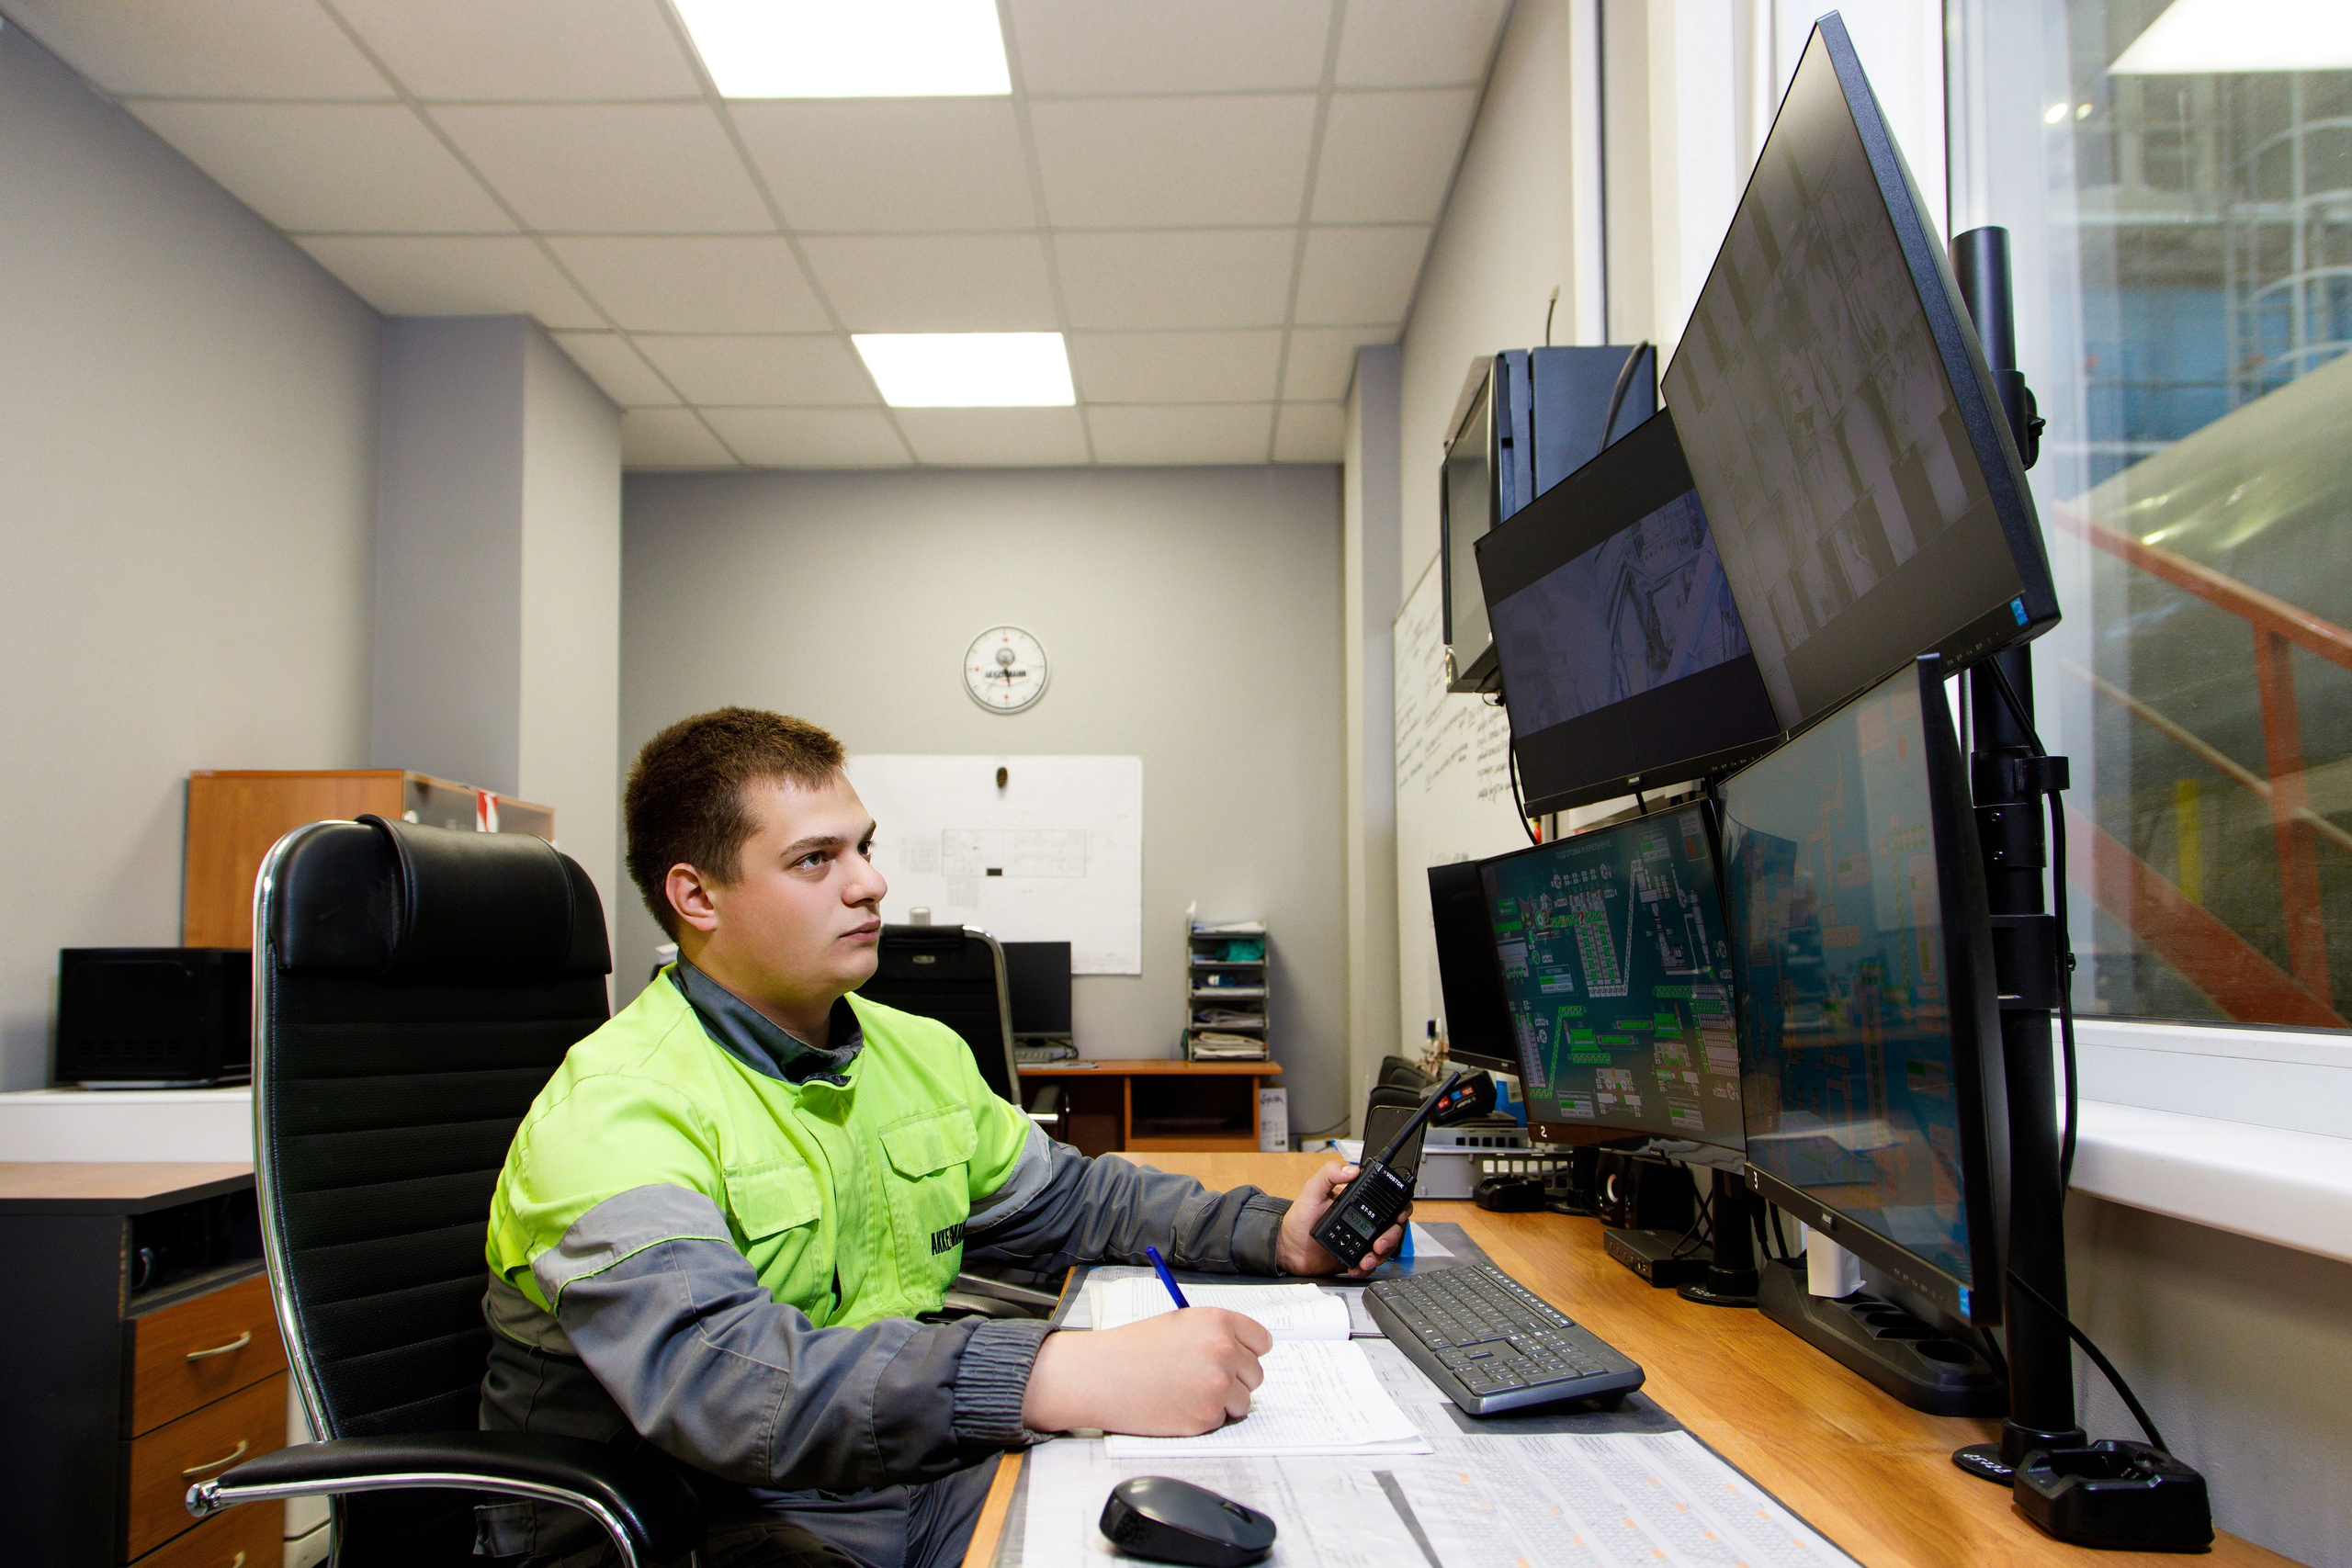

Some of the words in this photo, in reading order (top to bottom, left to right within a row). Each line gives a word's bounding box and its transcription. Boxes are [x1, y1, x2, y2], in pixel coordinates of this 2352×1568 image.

[1541, 1125, 1547, 1138] 2
[1386, 1171, 1405, 1190] VOSTOK
[1361, 1204, 1376, 1219] ST-55
